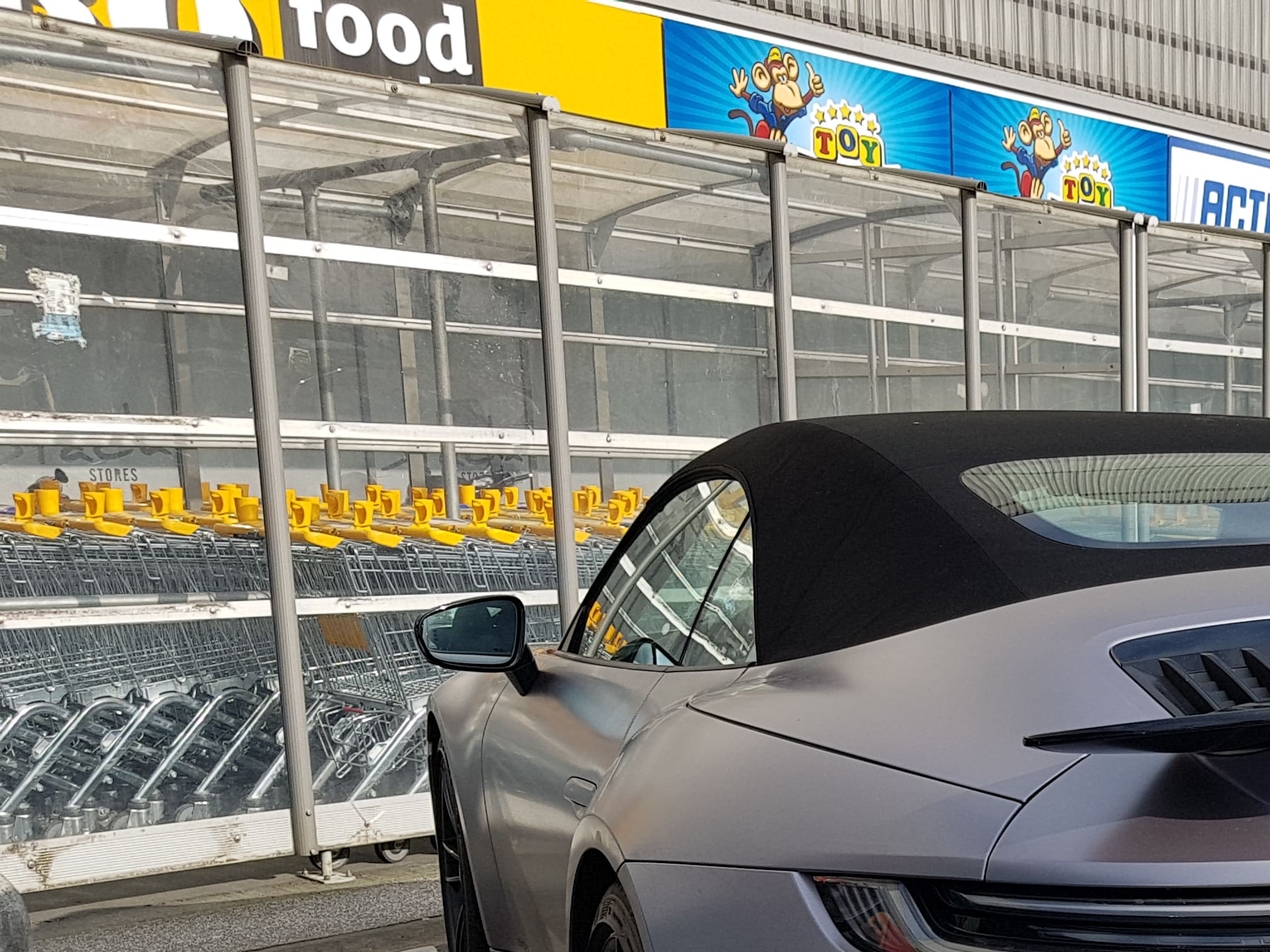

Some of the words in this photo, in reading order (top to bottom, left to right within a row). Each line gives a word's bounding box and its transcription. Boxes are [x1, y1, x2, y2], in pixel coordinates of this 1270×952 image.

[287, 0, 474, 76] food
[815, 128, 879, 164] TOY
[1064, 176, 1110, 206] TOY
[89, 468, 138, 482] STORES
